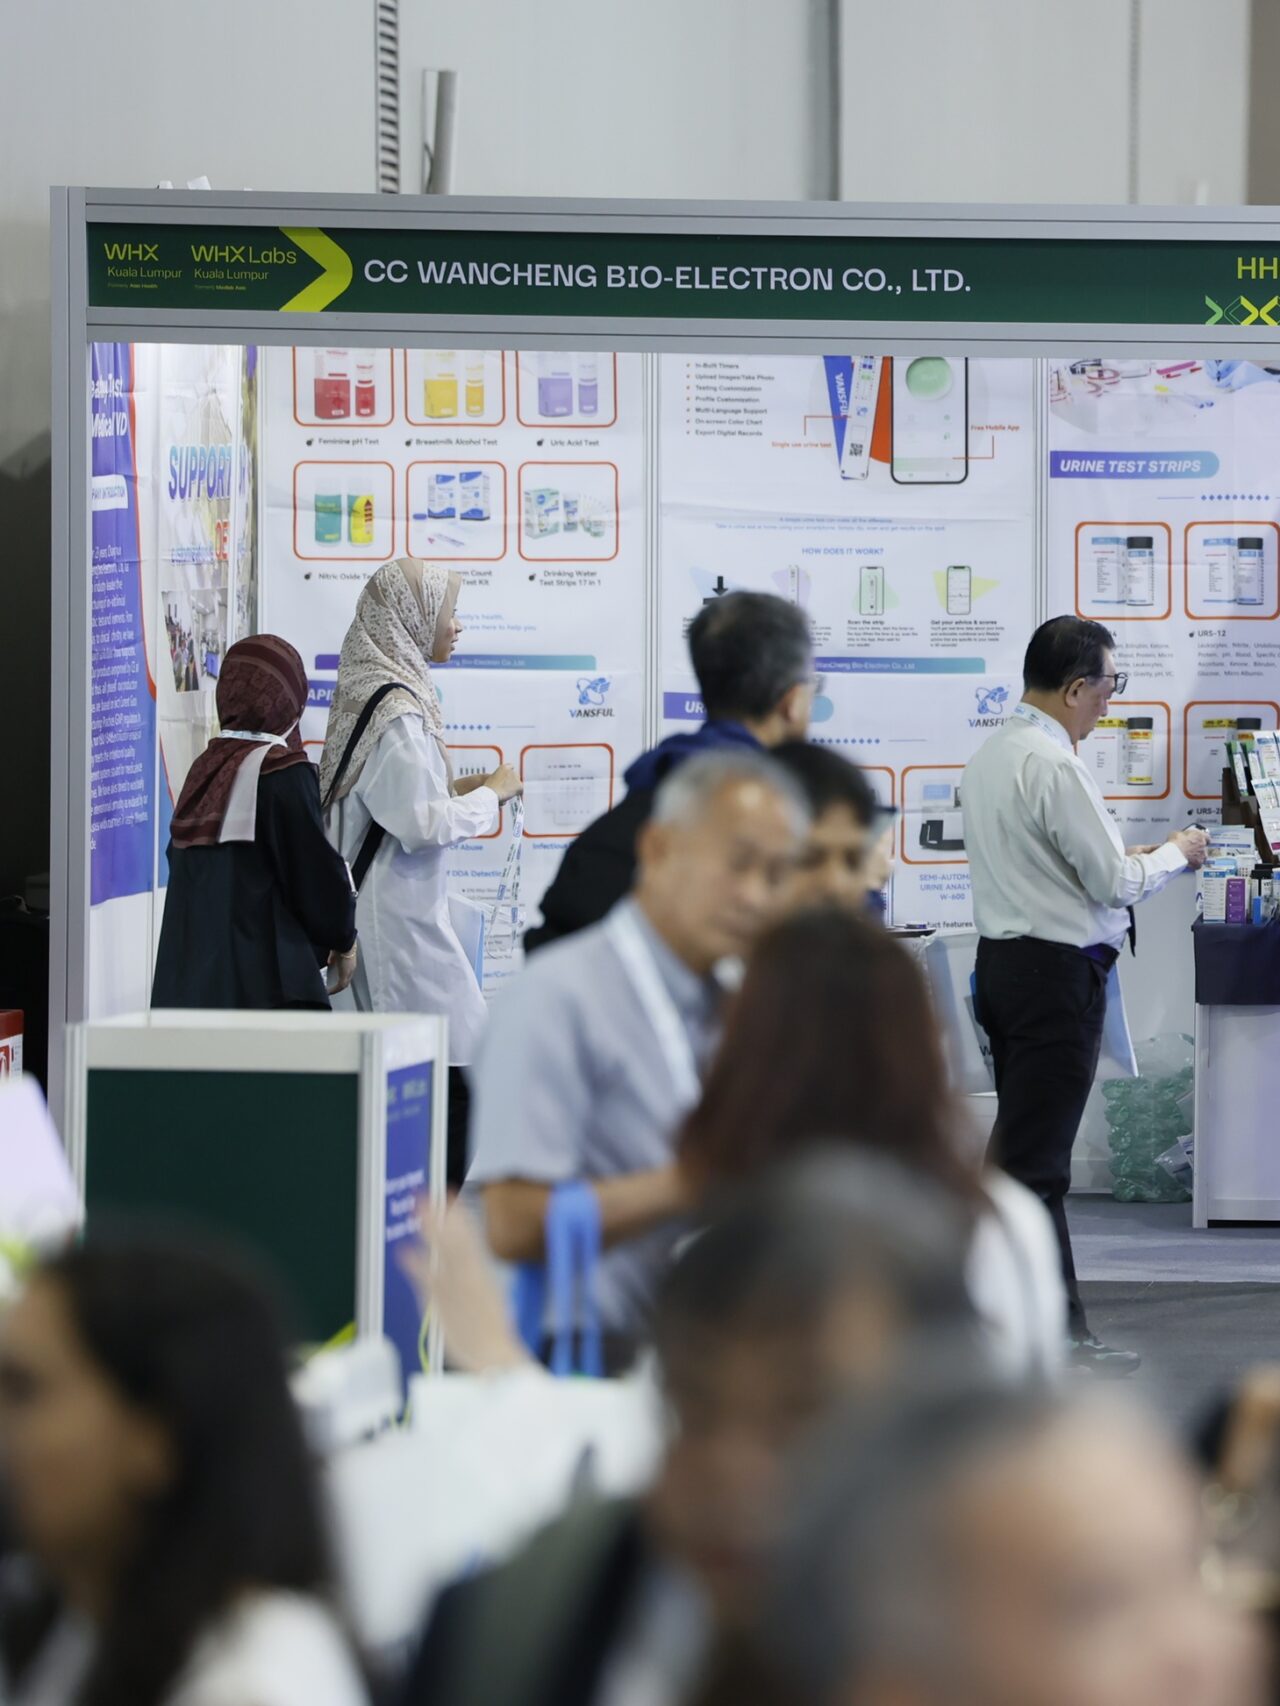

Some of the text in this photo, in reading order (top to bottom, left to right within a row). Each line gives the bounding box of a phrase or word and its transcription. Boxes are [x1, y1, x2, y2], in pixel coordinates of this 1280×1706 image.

[104, 243, 159, 261] WHX
[191, 245, 297, 264] WHX Labs
[108, 266, 182, 280] Kuala Lumpur
[194, 268, 268, 281] Kuala Lumpur
[364, 260, 972, 294] CC WANCHENG BIO-ELECTRON CO., LTD.
[1060, 459, 1200, 473] URINE TEST STRIPS
[802, 548, 884, 556] HOW DOES IT WORK?
[569, 708, 615, 718] VANSFUL
